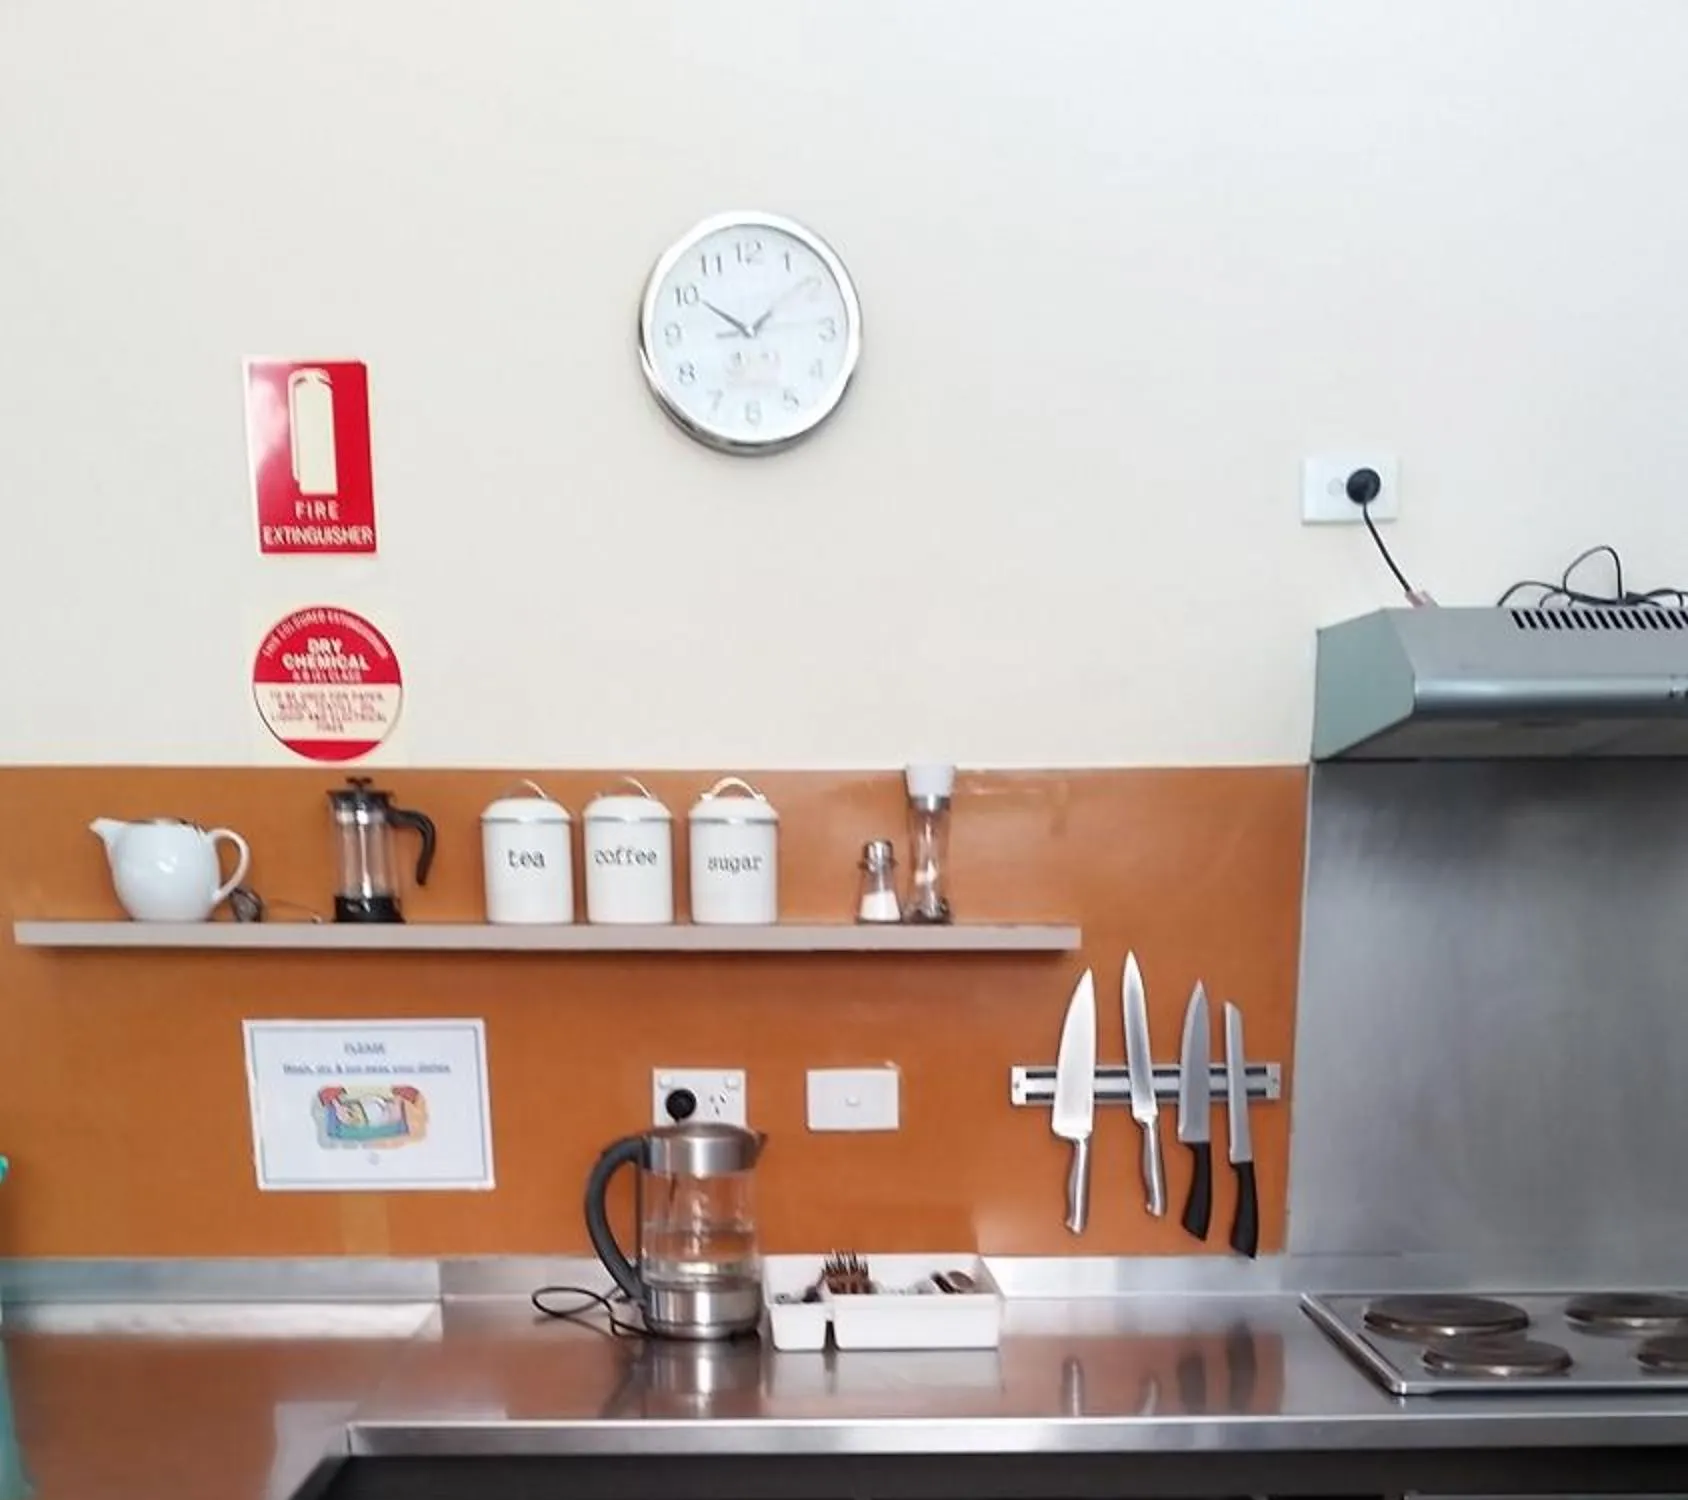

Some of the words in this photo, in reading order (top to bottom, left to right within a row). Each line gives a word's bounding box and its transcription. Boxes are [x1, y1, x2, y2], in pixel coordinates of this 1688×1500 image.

[735, 240, 764, 266] 12
[783, 251, 792, 273] 1
[700, 254, 723, 276] 11
[674, 282, 701, 307] 10
[663, 322, 682, 348] 9
[817, 316, 837, 343] 3
[676, 358, 698, 387] 8
[808, 358, 825, 380] 4
[706, 388, 724, 412] 7
[783, 387, 801, 412] 5
[744, 400, 763, 426] 6
[294, 500, 340, 521] FIRE
[262, 525, 375, 546] EXTINGUISHER
[307, 637, 343, 654] DRY
[281, 652, 371, 671] CHEMICAL
[508, 848, 546, 870] tea
[594, 844, 658, 867] coffee
[706, 854, 764, 875] sugar
